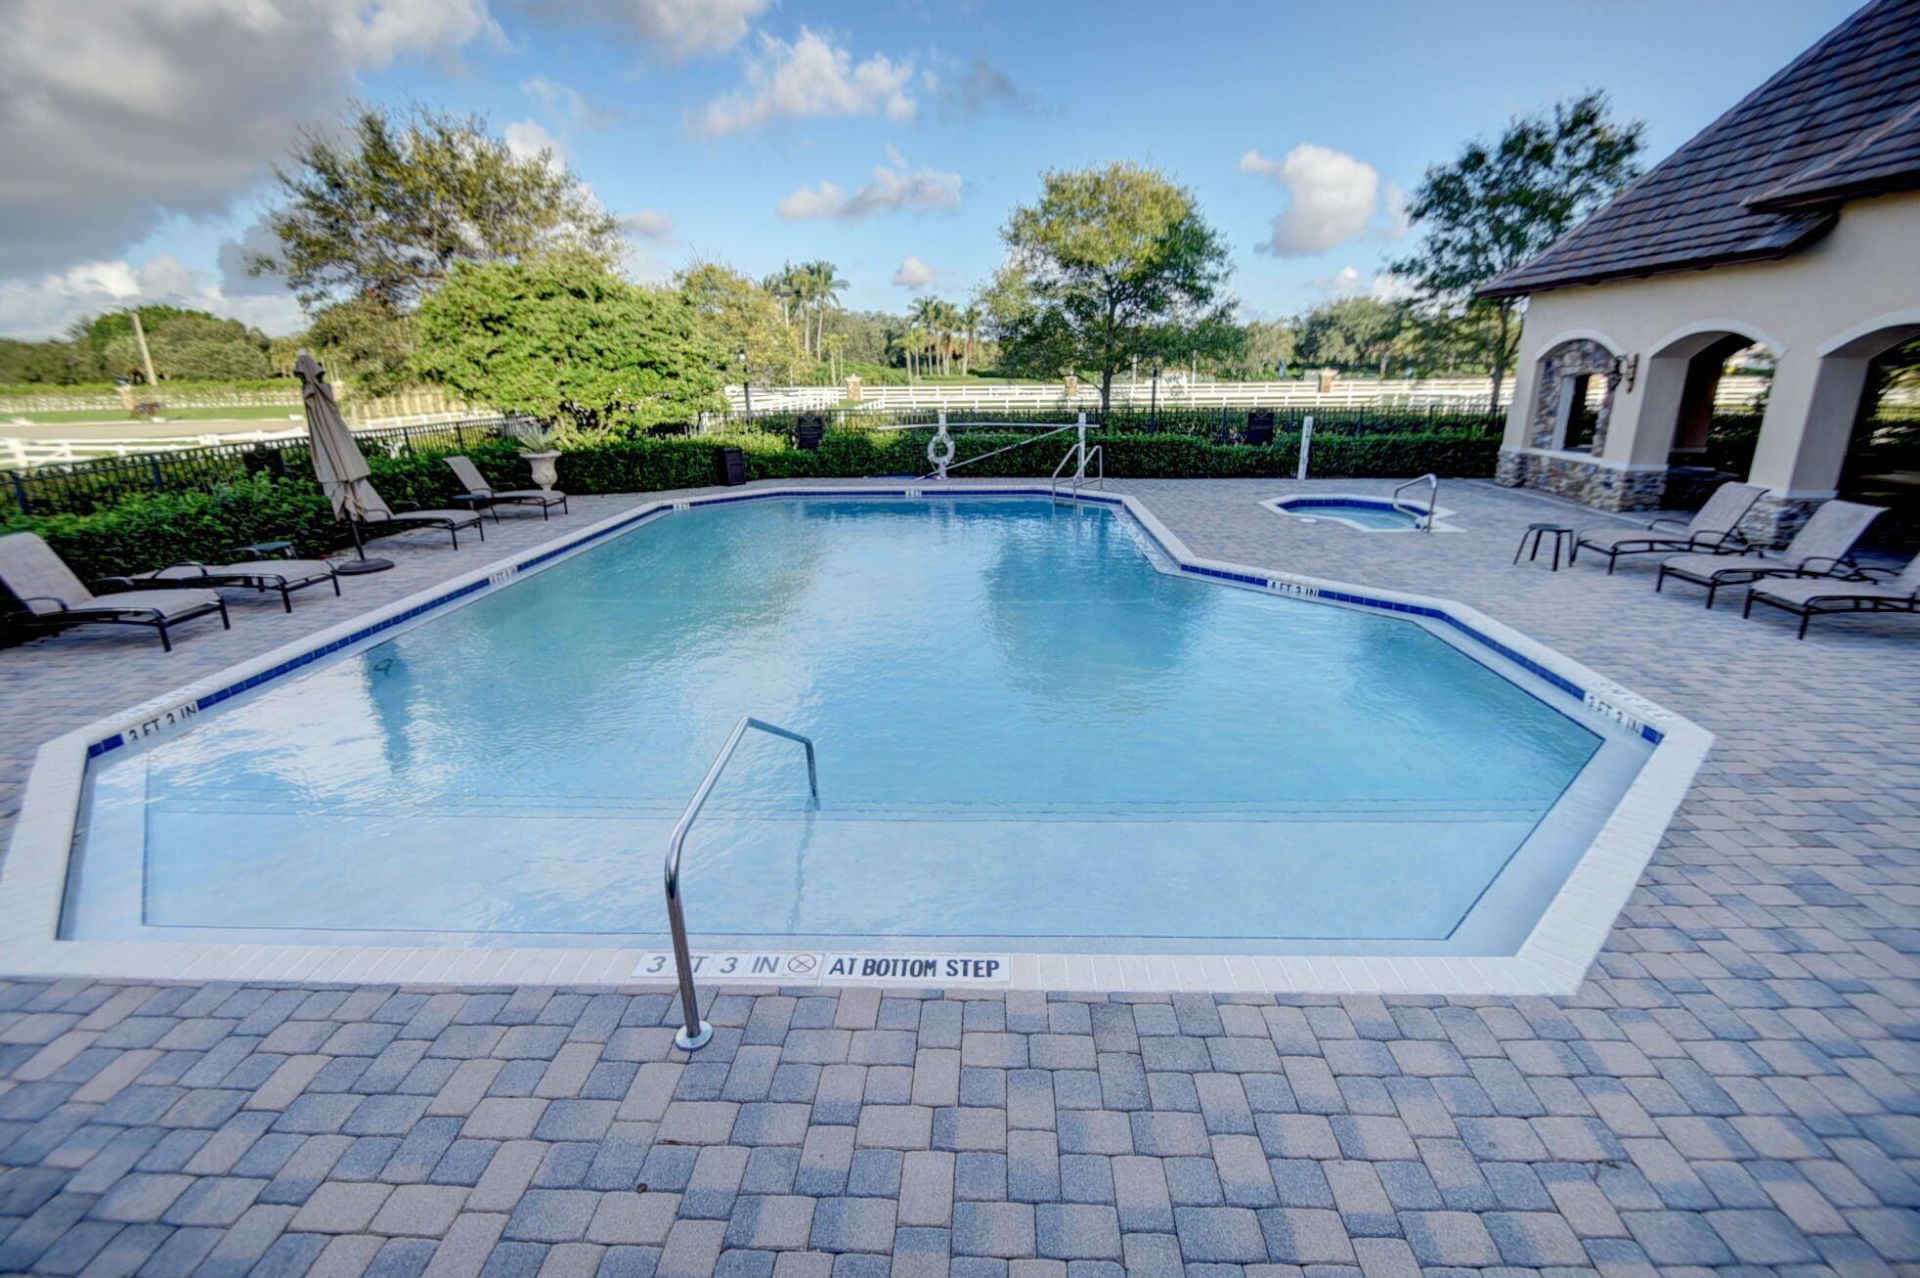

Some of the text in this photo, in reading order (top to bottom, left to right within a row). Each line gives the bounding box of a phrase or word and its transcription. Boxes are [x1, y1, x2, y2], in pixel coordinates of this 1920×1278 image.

[1305, 587, 1317, 597] IN
[142, 718, 160, 737] FT
[180, 703, 197, 719] IN
[646, 955, 667, 973] 3
[719, 956, 739, 974] 3
[751, 956, 780, 974] IN
[829, 957, 1001, 979] AT BOTTOM STEP
